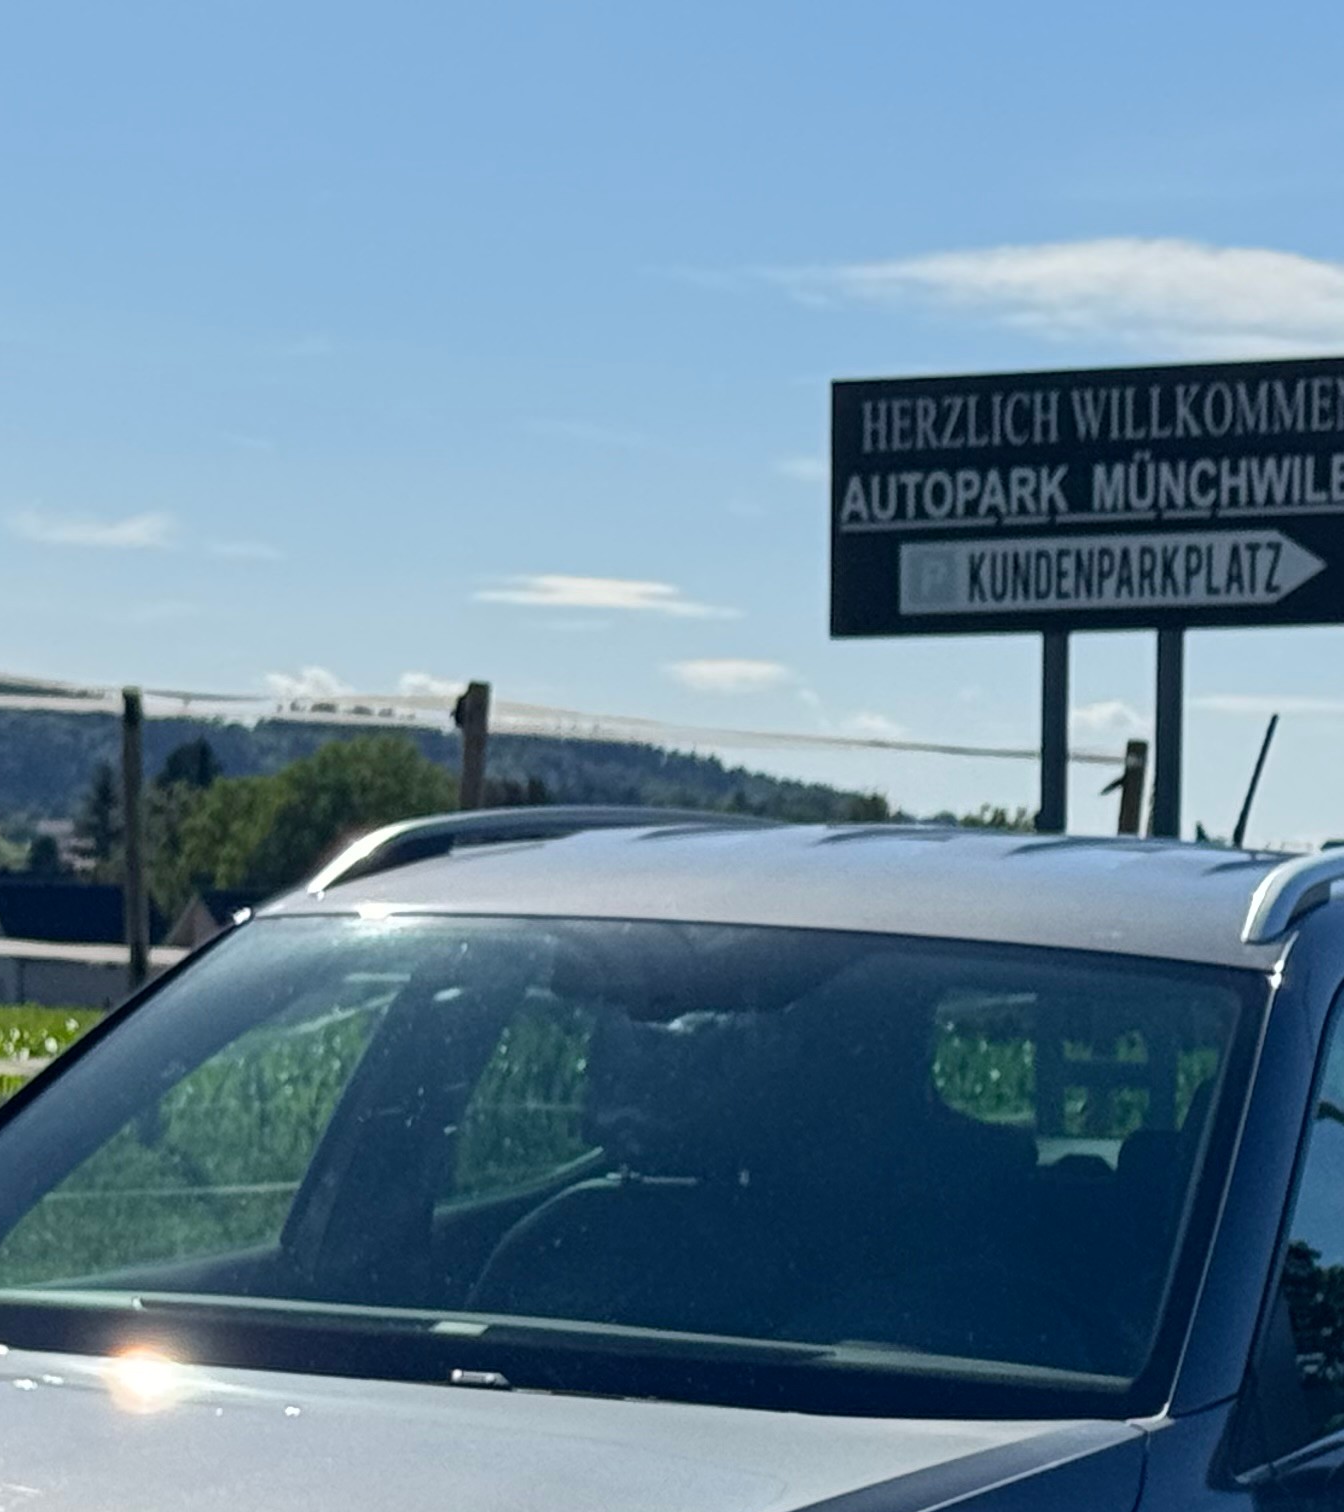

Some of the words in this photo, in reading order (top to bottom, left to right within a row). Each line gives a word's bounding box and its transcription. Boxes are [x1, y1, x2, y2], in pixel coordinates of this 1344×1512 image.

[861, 389, 1060, 453] HERZLICH
[839, 462, 1070, 524] AUTOPARK
[966, 541, 1284, 604] KUNDENPARKPLATZ
